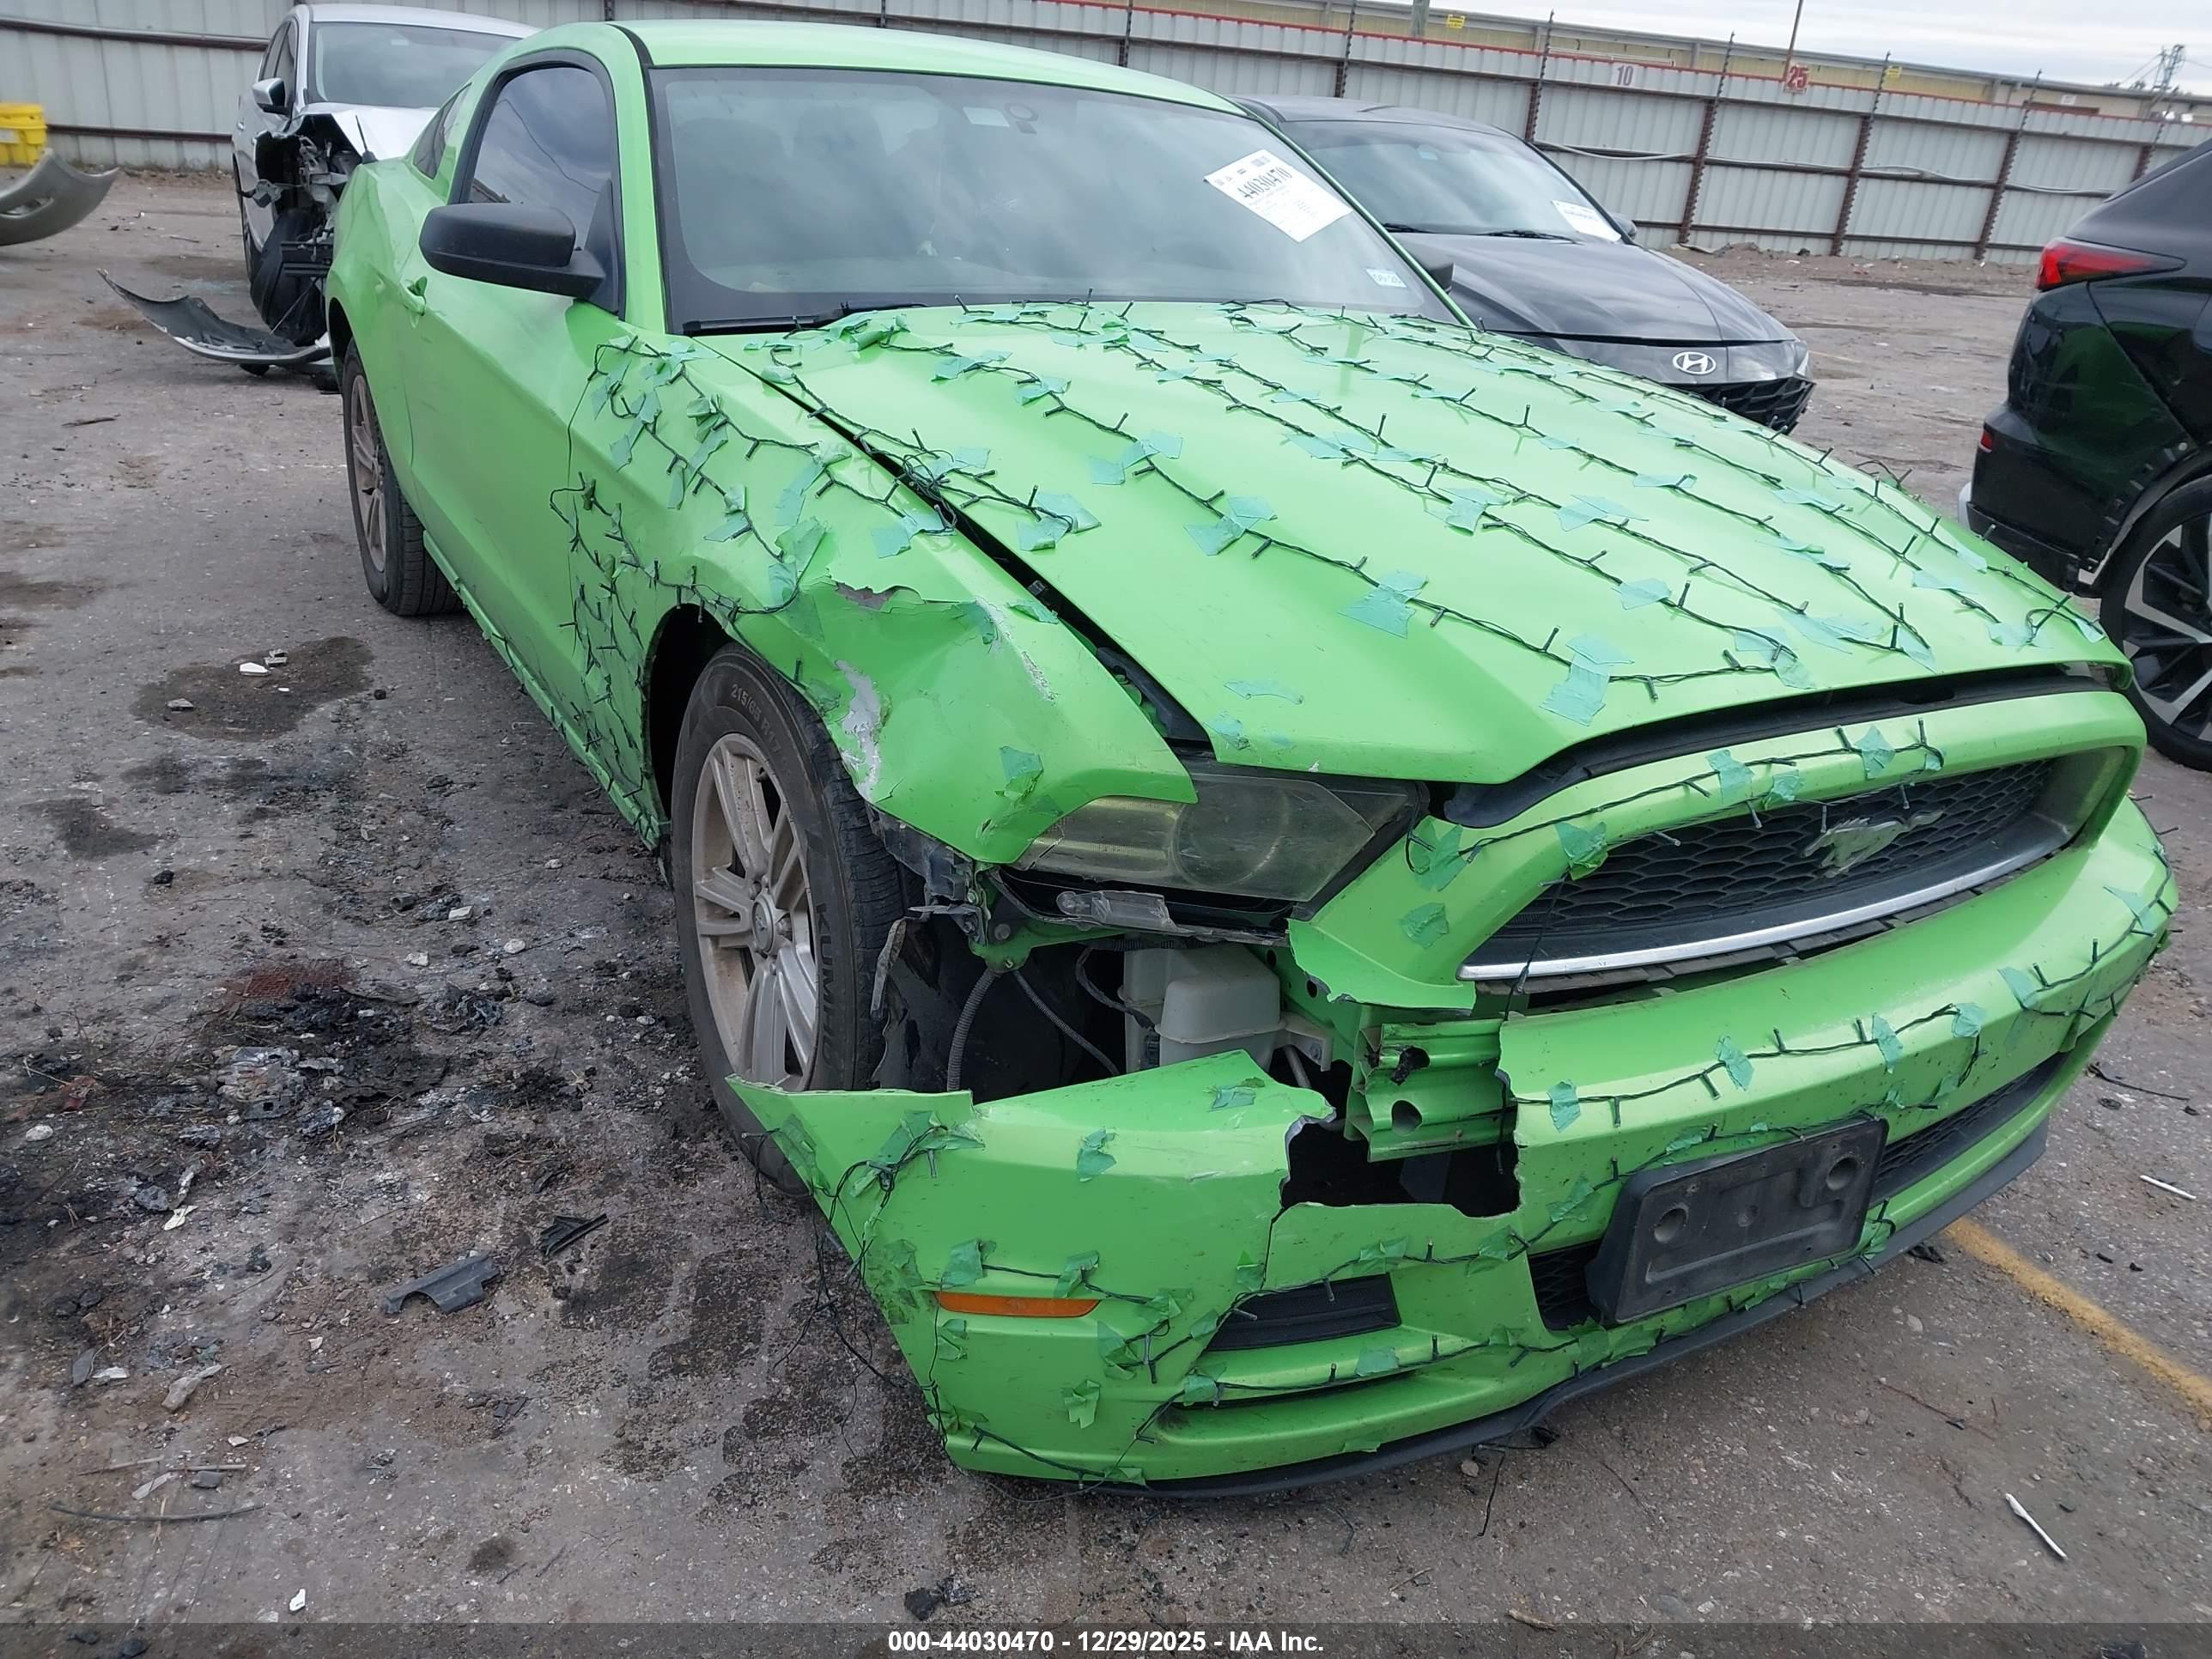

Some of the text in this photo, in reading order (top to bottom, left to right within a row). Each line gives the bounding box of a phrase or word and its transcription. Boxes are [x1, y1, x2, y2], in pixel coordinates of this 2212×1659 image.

[1616, 64, 1634, 86] 10
[1788, 65, 1808, 89] 25
[1237, 166, 1292, 199] 44030470
[731, 684, 762, 722] 215/65
[816, 902, 835, 1067] KUMHO
